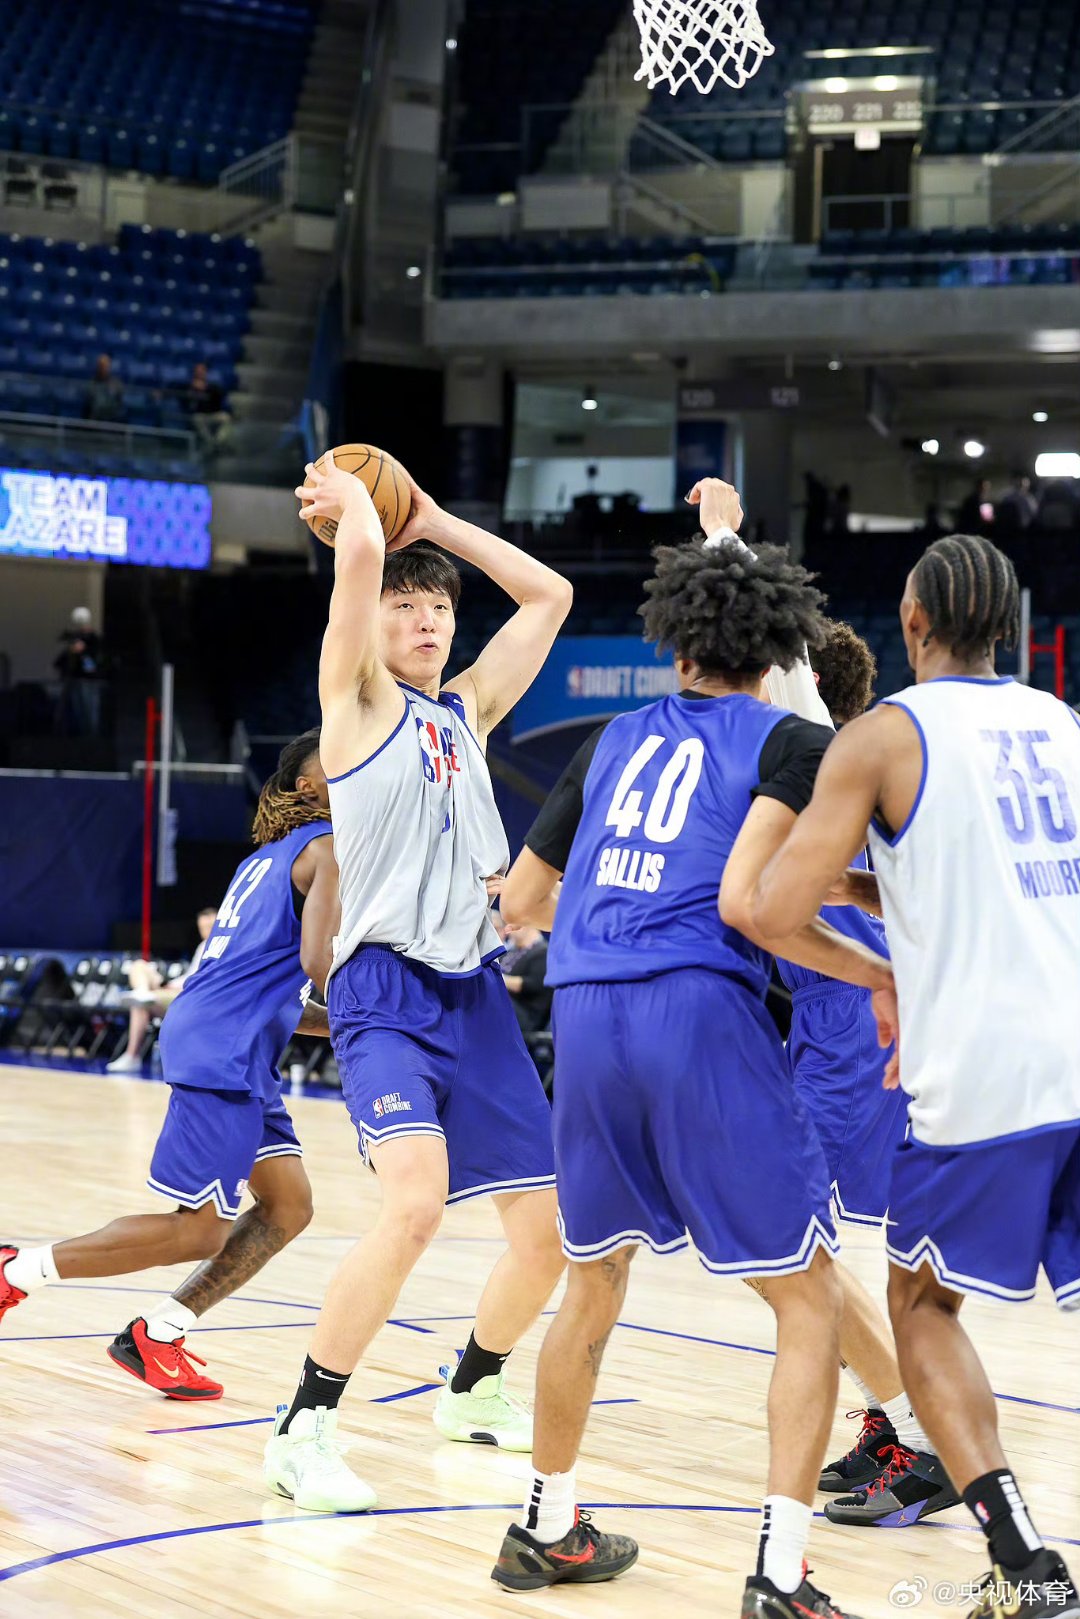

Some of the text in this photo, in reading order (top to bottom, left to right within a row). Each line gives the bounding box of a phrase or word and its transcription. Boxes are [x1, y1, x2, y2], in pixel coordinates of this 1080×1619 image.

[2, 474, 108, 515] TEAM
[0, 512, 127, 556] AZARE
[582, 666, 632, 698] DRAFT
[605, 734, 704, 843] 40
[978, 729, 1078, 845] 35
[216, 857, 273, 928] 42
[596, 848, 666, 893] SALLIS
[381, 1092, 400, 1104] DRAFT
[383, 1101, 412, 1113] COMBINE
